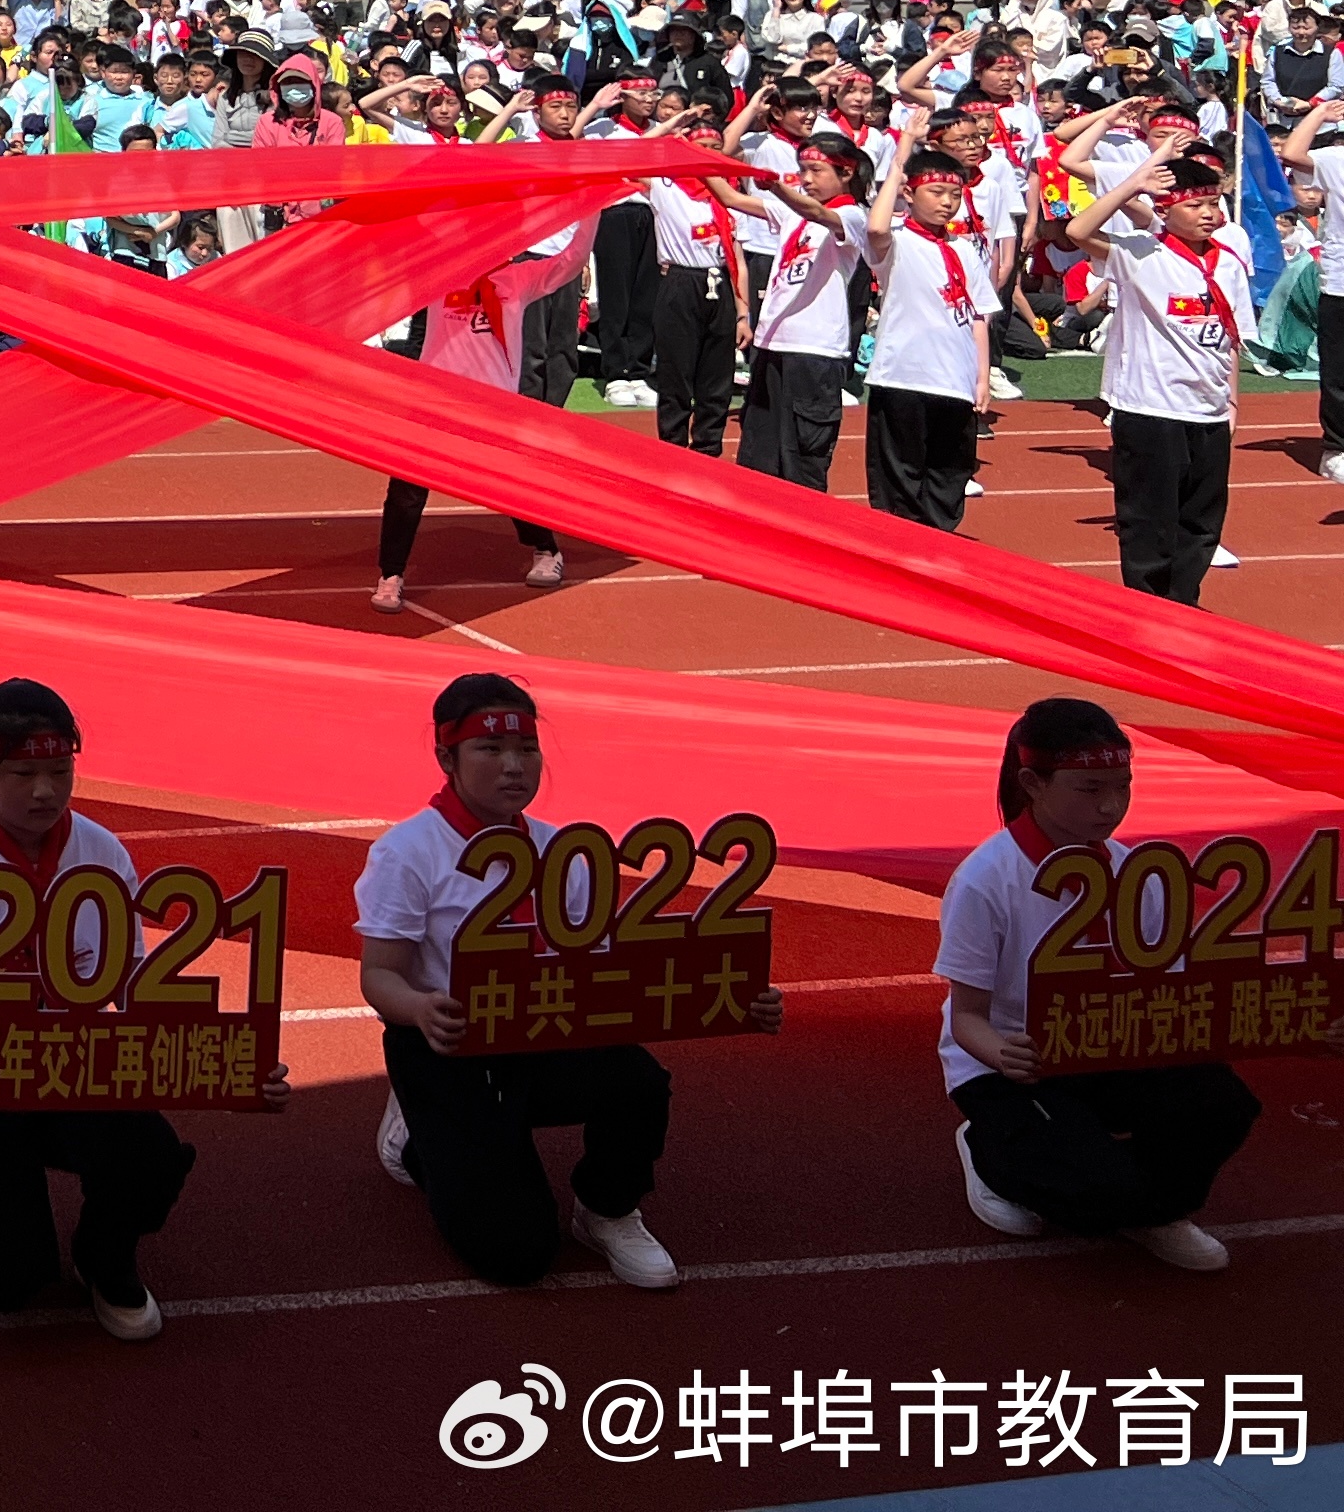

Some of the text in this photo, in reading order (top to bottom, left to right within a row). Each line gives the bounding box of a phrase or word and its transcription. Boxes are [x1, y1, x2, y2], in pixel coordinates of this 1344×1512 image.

[458, 817, 777, 952] 2022
[1033, 837, 1343, 974] 2024
[469, 953, 748, 1044] 中共二十大
[1042, 973, 1331, 1064] 永远听党话 跟党走
